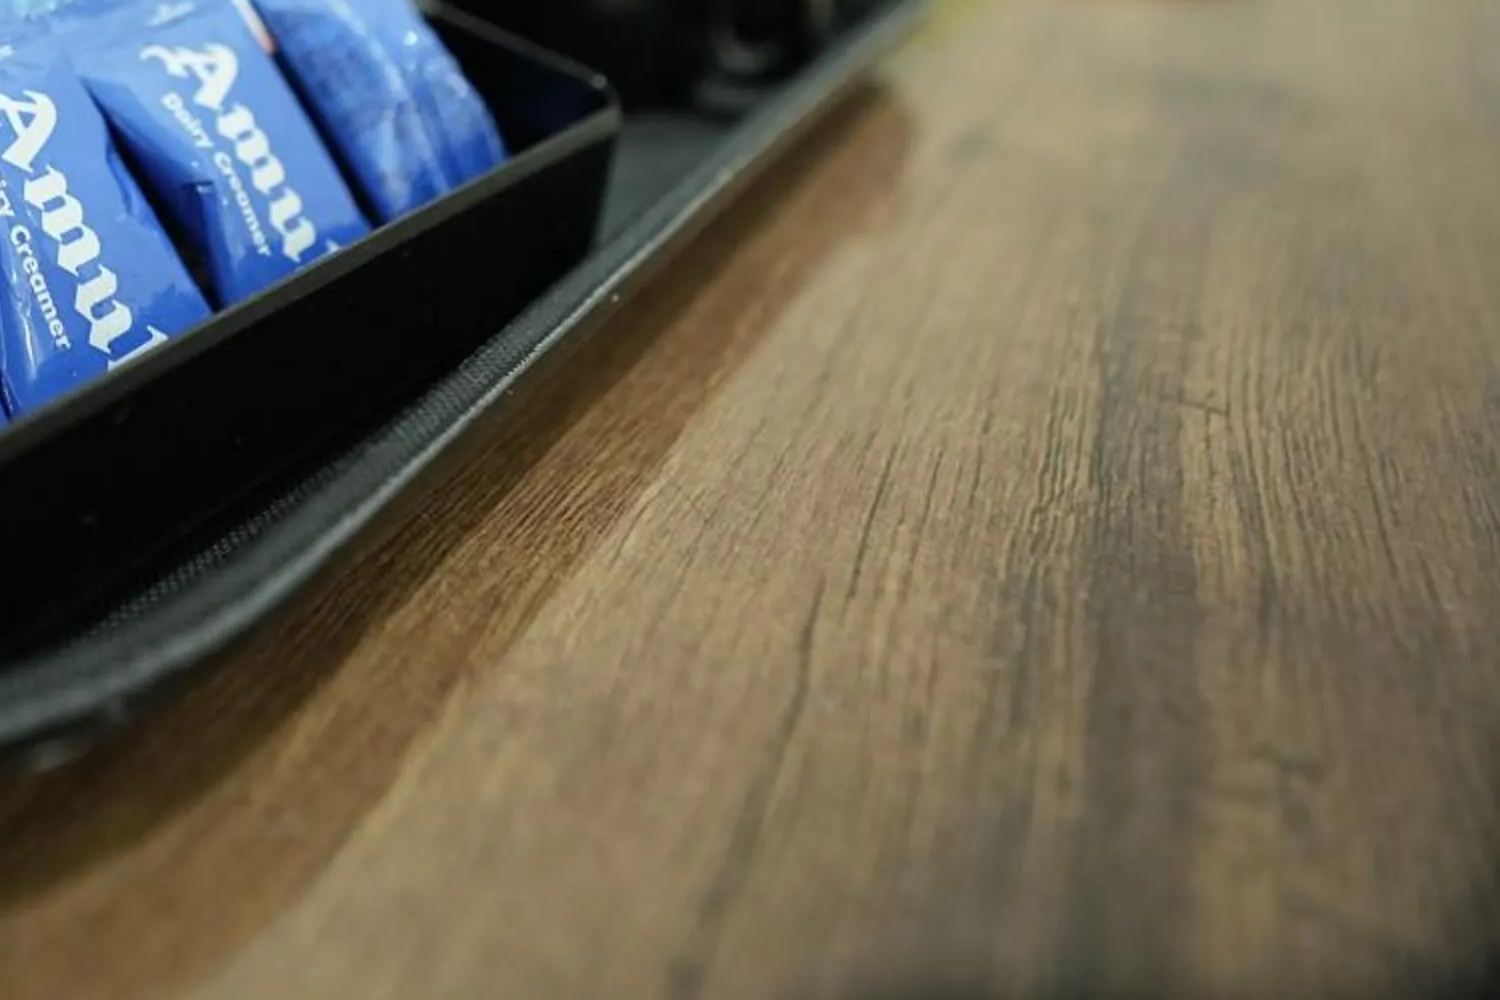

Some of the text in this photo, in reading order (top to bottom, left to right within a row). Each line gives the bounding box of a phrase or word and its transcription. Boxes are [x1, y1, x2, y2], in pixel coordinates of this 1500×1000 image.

[137, 43, 340, 264] Amu
[161, 92, 215, 148] Dairy
[213, 151, 272, 257] Creamer
[9, 224, 72, 349] Creamer
